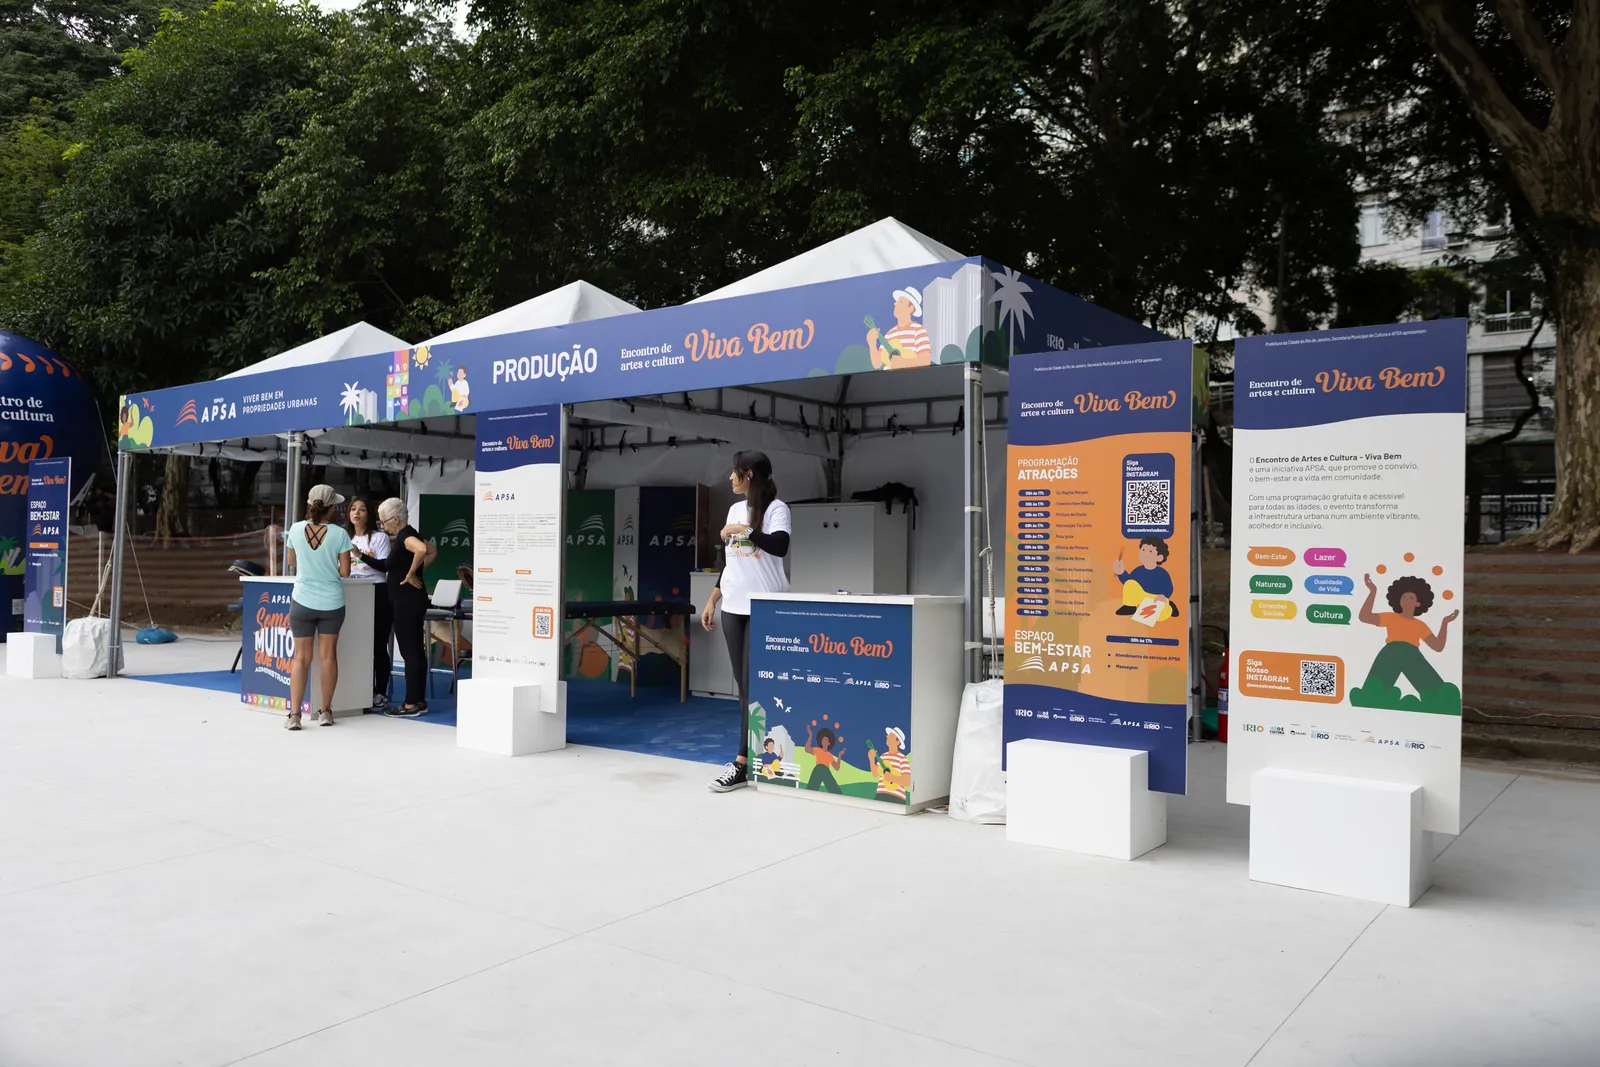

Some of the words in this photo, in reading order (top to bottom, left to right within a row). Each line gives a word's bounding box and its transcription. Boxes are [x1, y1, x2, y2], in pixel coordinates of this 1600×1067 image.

[684, 328, 743, 362] Viva
[748, 319, 814, 354] Bem
[1050, 334, 1064, 350] RIO
[621, 346, 659, 359] Encontro
[661, 343, 672, 354] de
[492, 344, 598, 384] PRODUÇÃO
[620, 359, 643, 371] artes
[645, 360, 650, 368] e
[652, 354, 684, 367] cultura
[1249, 380, 1289, 389] Encontro
[1292, 378, 1302, 386] de
[1315, 369, 1375, 393] Viva
[1379, 366, 1446, 389] Bem
[242, 394, 259, 404] VIVER
[261, 392, 274, 401] BEM
[275, 390, 284, 399] EM
[1249, 389, 1272, 398] artes
[1281, 386, 1315, 395] cultura
[0, 396, 23, 407] tro
[27, 396, 43, 408] de
[243, 401, 285, 414] PROPRIEDADES
[287, 397, 318, 409] URBANAS
[1021, 402, 1053, 410] Encontro
[1074, 392, 1121, 414] Viva
[1124, 390, 1177, 410] Bem
[1, 409, 54, 422] cultura
[201, 402, 236, 423] APSA
[506, 435, 529, 450] Viva
[530, 435, 554, 448] Bem
[1018, 456, 1079, 468] PROGRAMAÇÃO
[1018, 466, 1078, 482] ATRAÇÕES
[1283, 494, 1330, 502] programação
[30, 501, 46, 510] ESPAÇO
[30, 511, 60, 520] BEM-ESTAR
[43, 527, 59, 535] APSA
[430, 536, 470, 546] APSA
[566, 535, 606, 546] APSA
[617, 535, 634, 546] APSA
[649, 535, 696, 546] APSA
[271, 595, 291, 604] APSA
[256, 607, 291, 630] Somo
[1314, 610, 1344, 619] Cultura
[255, 627, 295, 658] MUITO
[1014, 630, 1054, 643] ESPAÇO
[809, 633, 848, 655] Viva
[850, 636, 893, 658] Bem
[1014, 642, 1091, 658] BEM-ESTAR
[255, 650, 274, 667] QUE
[1048, 661, 1091, 674] APSA
[761, 671, 774, 679] RIO
[1246, 674, 1289, 683] INSTAGRAM
[1018, 709, 1033, 717] RIO
[1246, 724, 1264, 732] RIO
